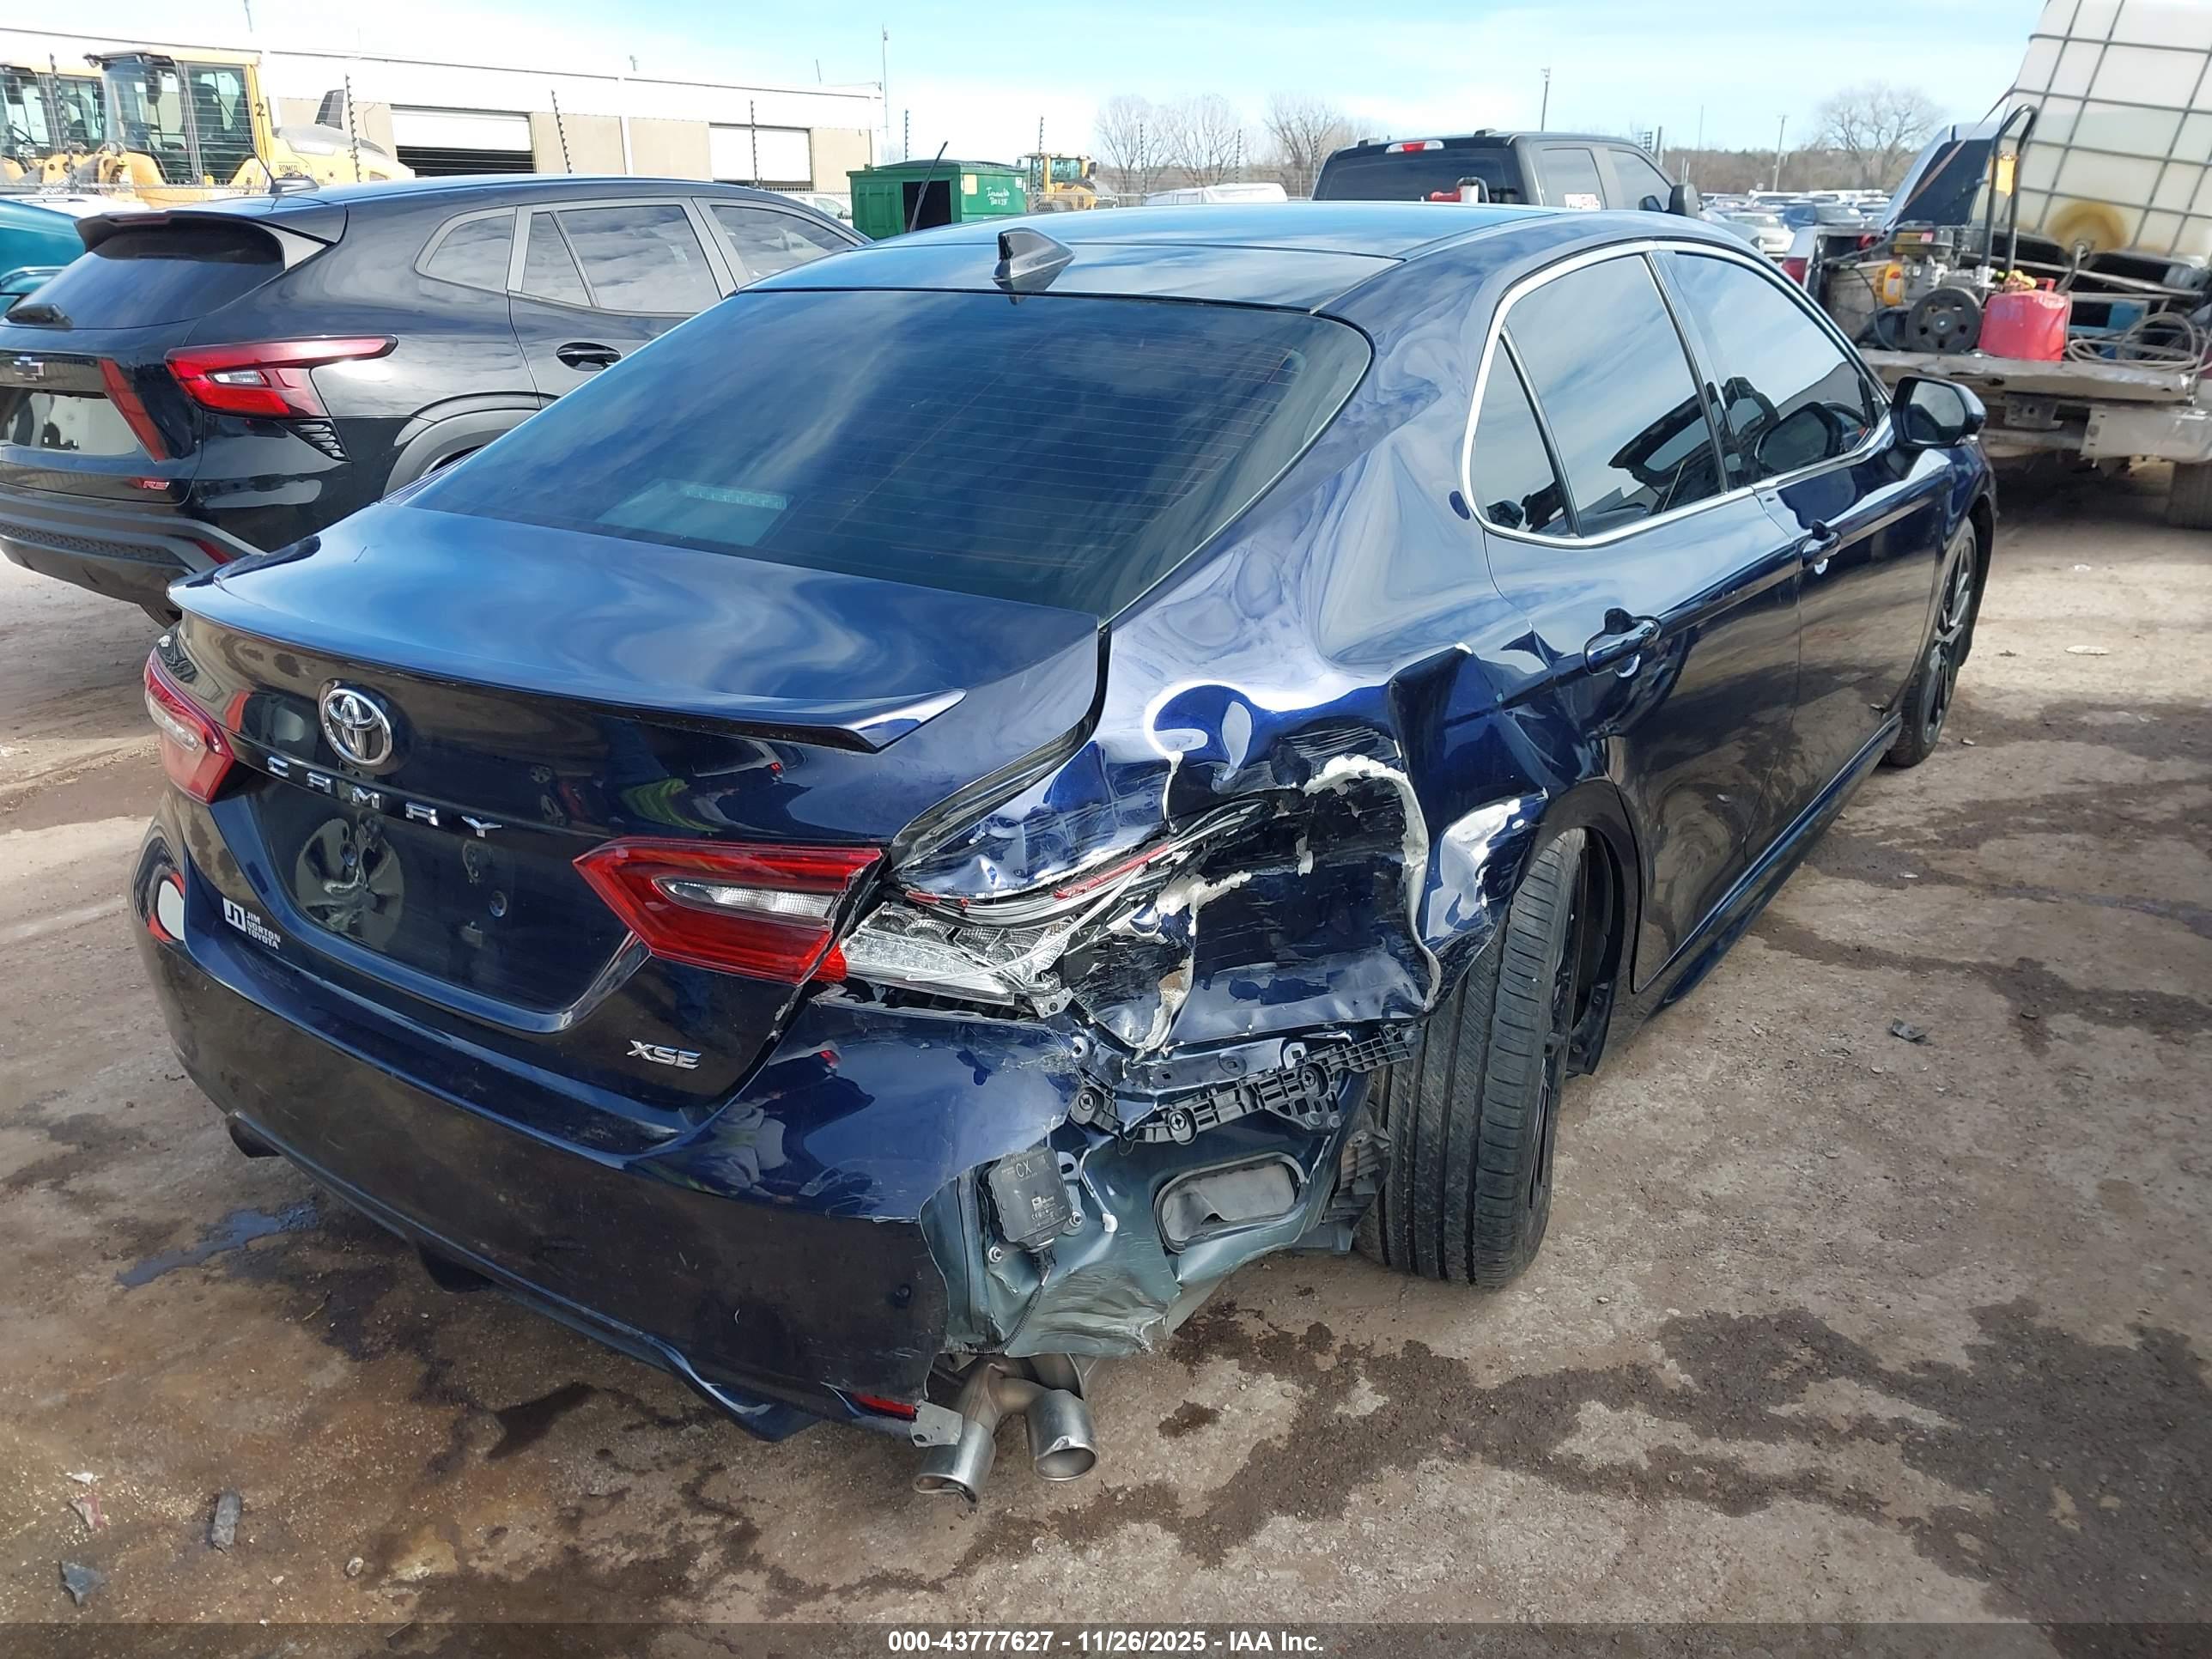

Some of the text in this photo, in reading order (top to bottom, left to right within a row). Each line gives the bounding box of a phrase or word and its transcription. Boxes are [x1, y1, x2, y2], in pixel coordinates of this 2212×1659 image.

[267, 756, 502, 839] CAMRY
[246, 911, 261, 925] JIM
[246, 920, 281, 943] NORTON
[247, 927, 279, 950] TOYOTA
[626, 1039, 702, 1070] XSE
[1016, 1160, 1031, 1178] CX
